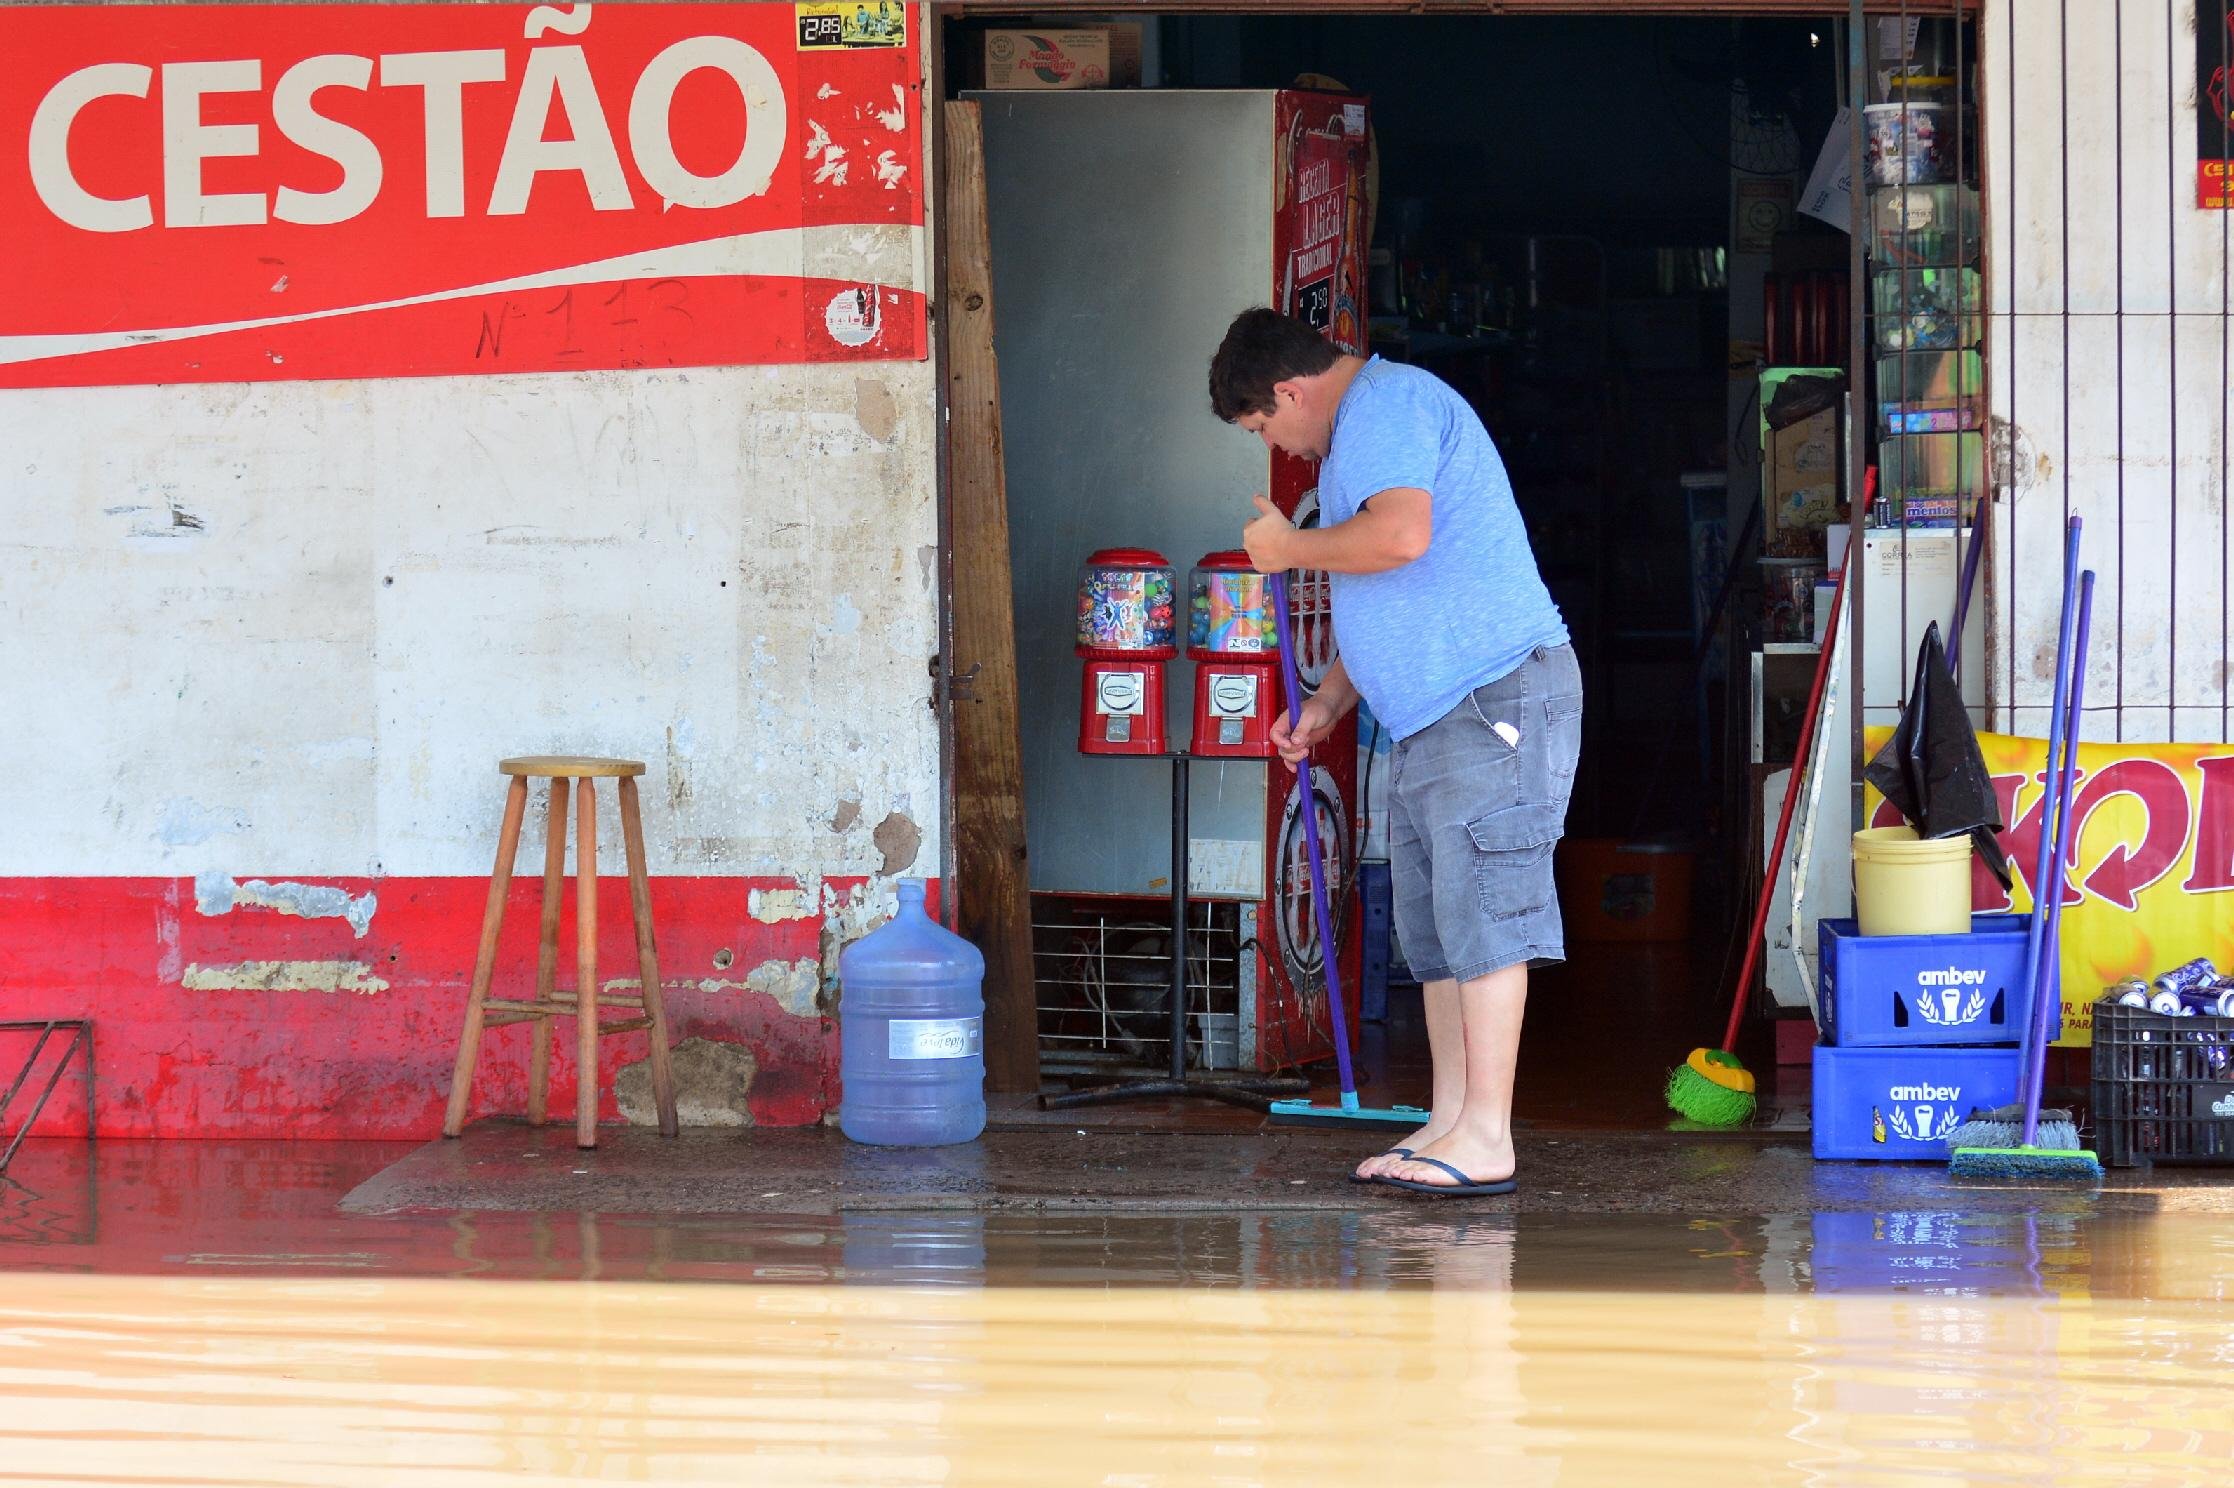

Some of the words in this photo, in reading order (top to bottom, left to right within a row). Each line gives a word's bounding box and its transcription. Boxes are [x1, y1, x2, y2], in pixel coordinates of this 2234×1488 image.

[28, 3, 788, 232] CESTÃO
[1302, 190, 1340, 250] LAGER
[1906, 505, 1957, 517] mentos
[1917, 966, 1986, 986] ambev
[1889, 1082, 1961, 1102] ambev
